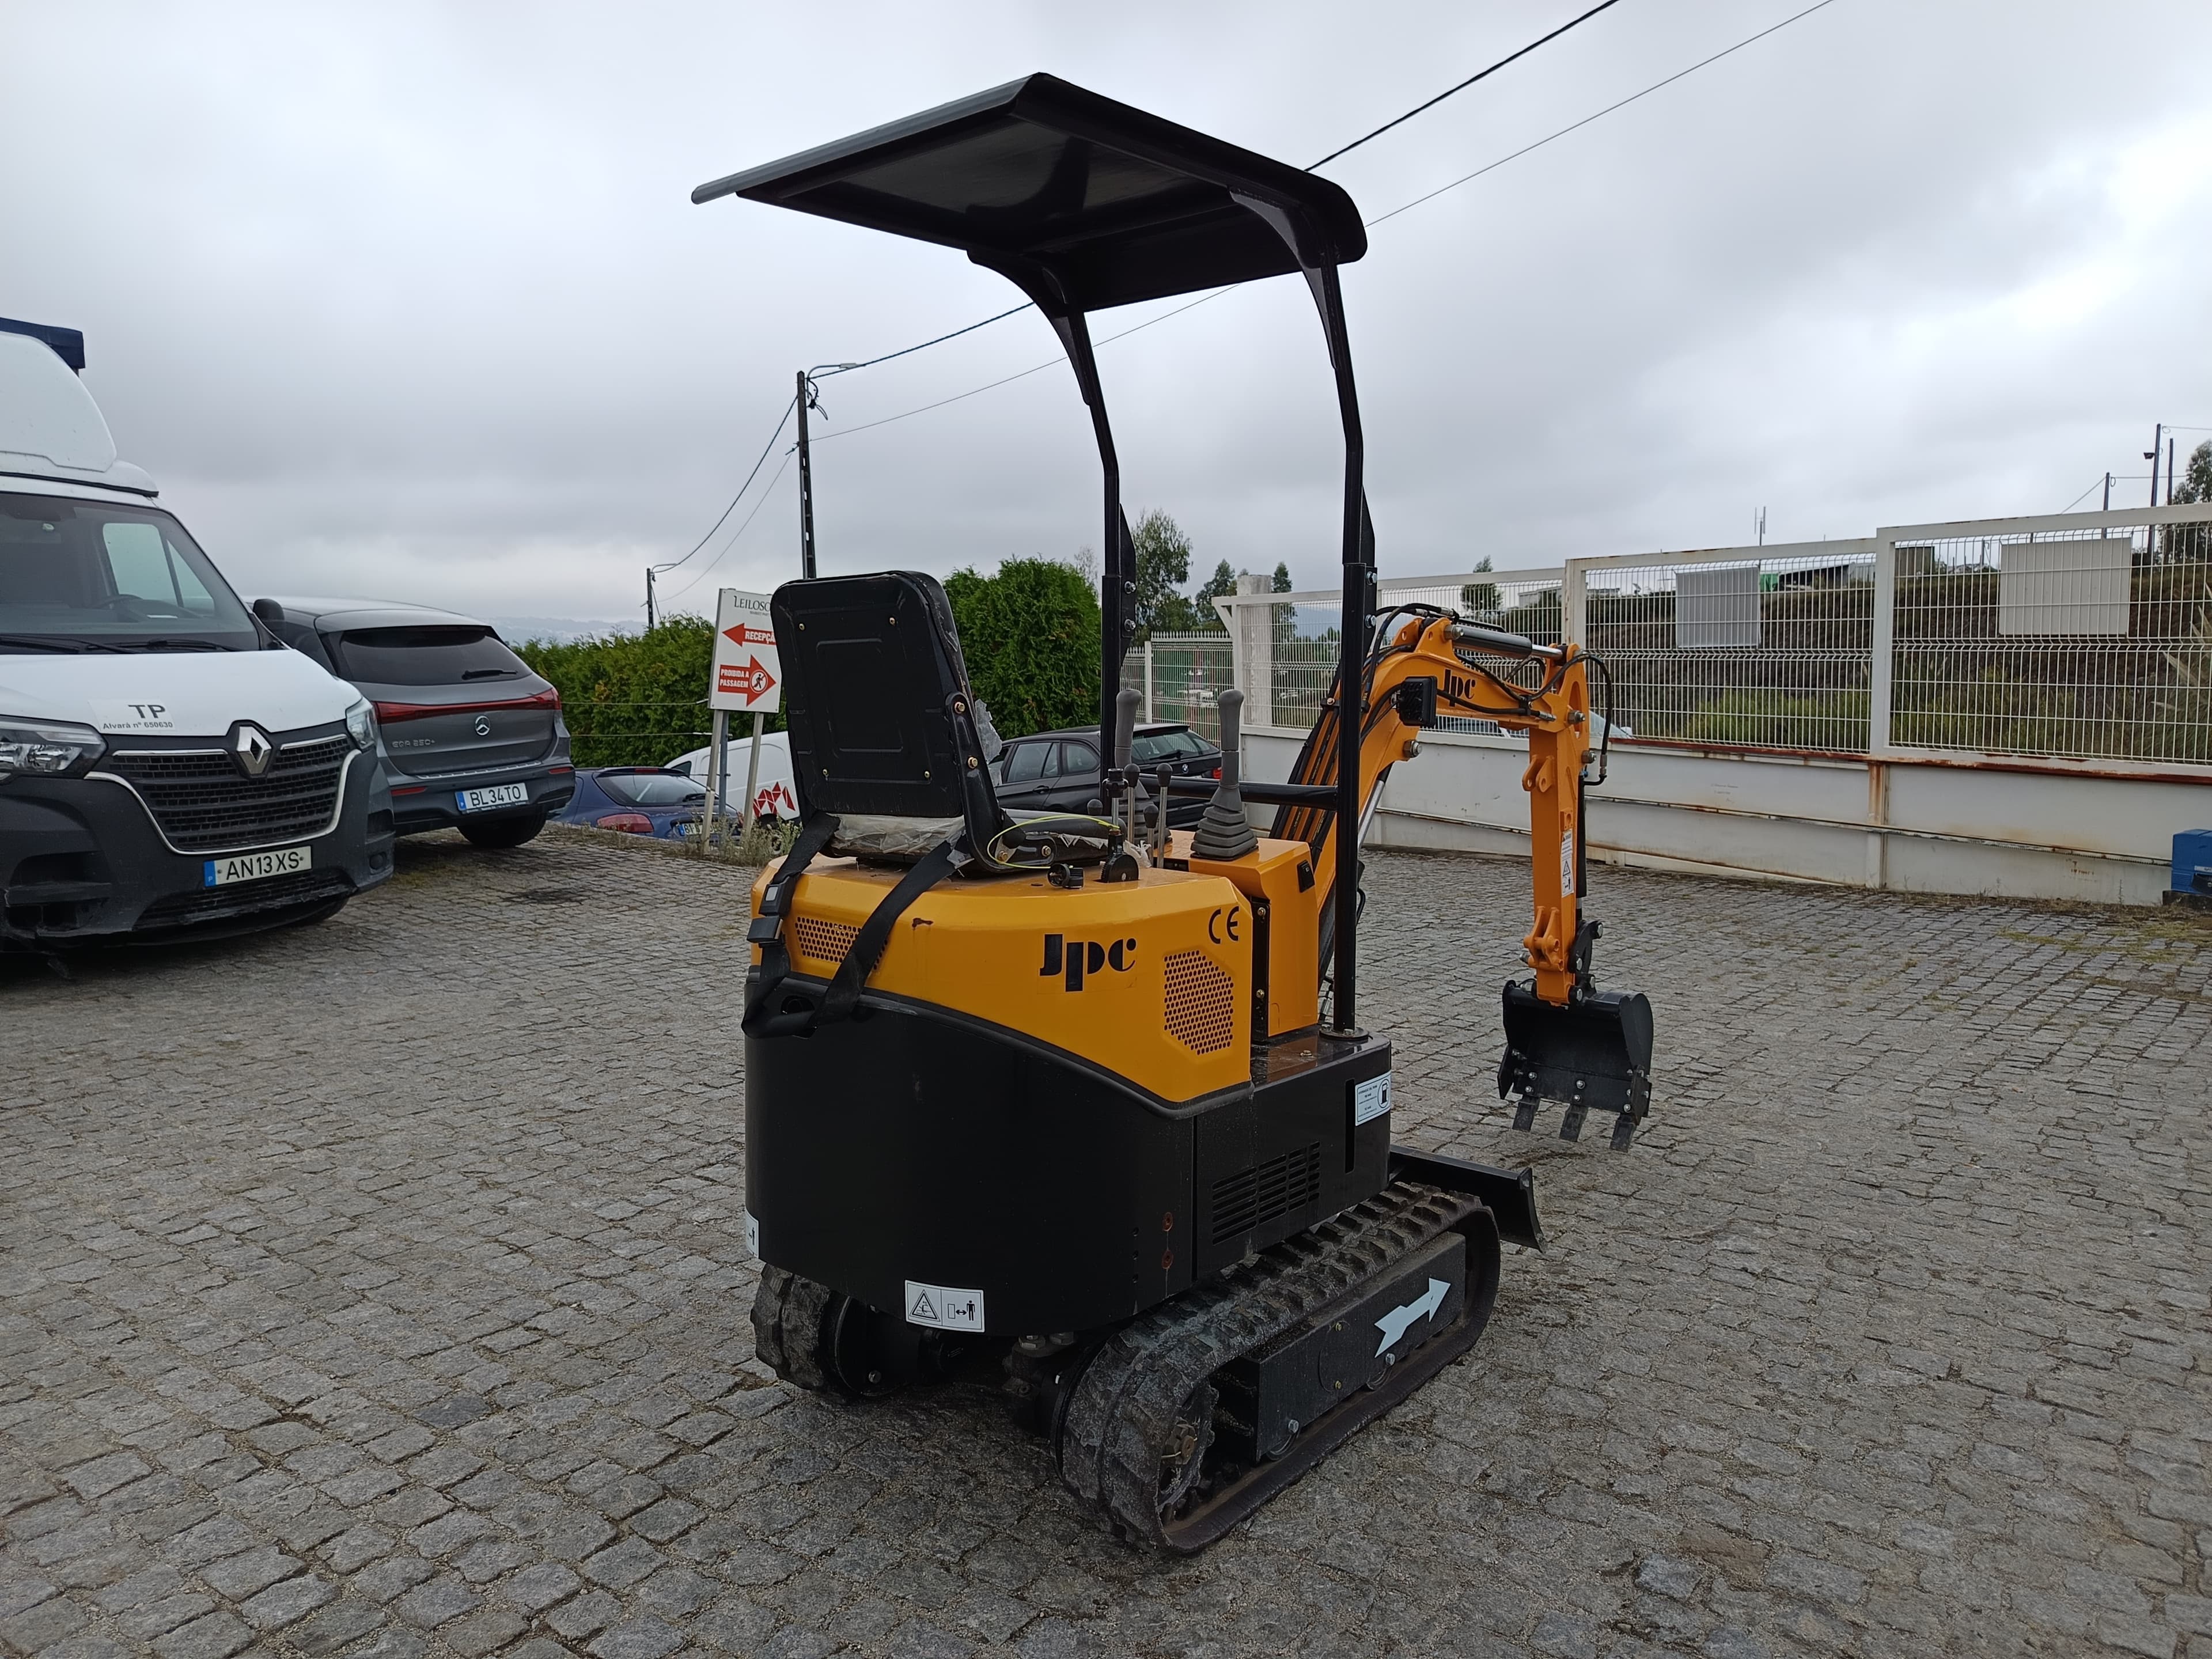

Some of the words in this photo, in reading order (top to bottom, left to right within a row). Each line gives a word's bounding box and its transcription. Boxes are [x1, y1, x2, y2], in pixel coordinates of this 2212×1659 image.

[721, 669, 745, 678] PROIBIDA
[719, 679, 749, 688] PASSAGEM
[128, 704, 165, 718] TP
[1209, 906, 1239, 944] CE
